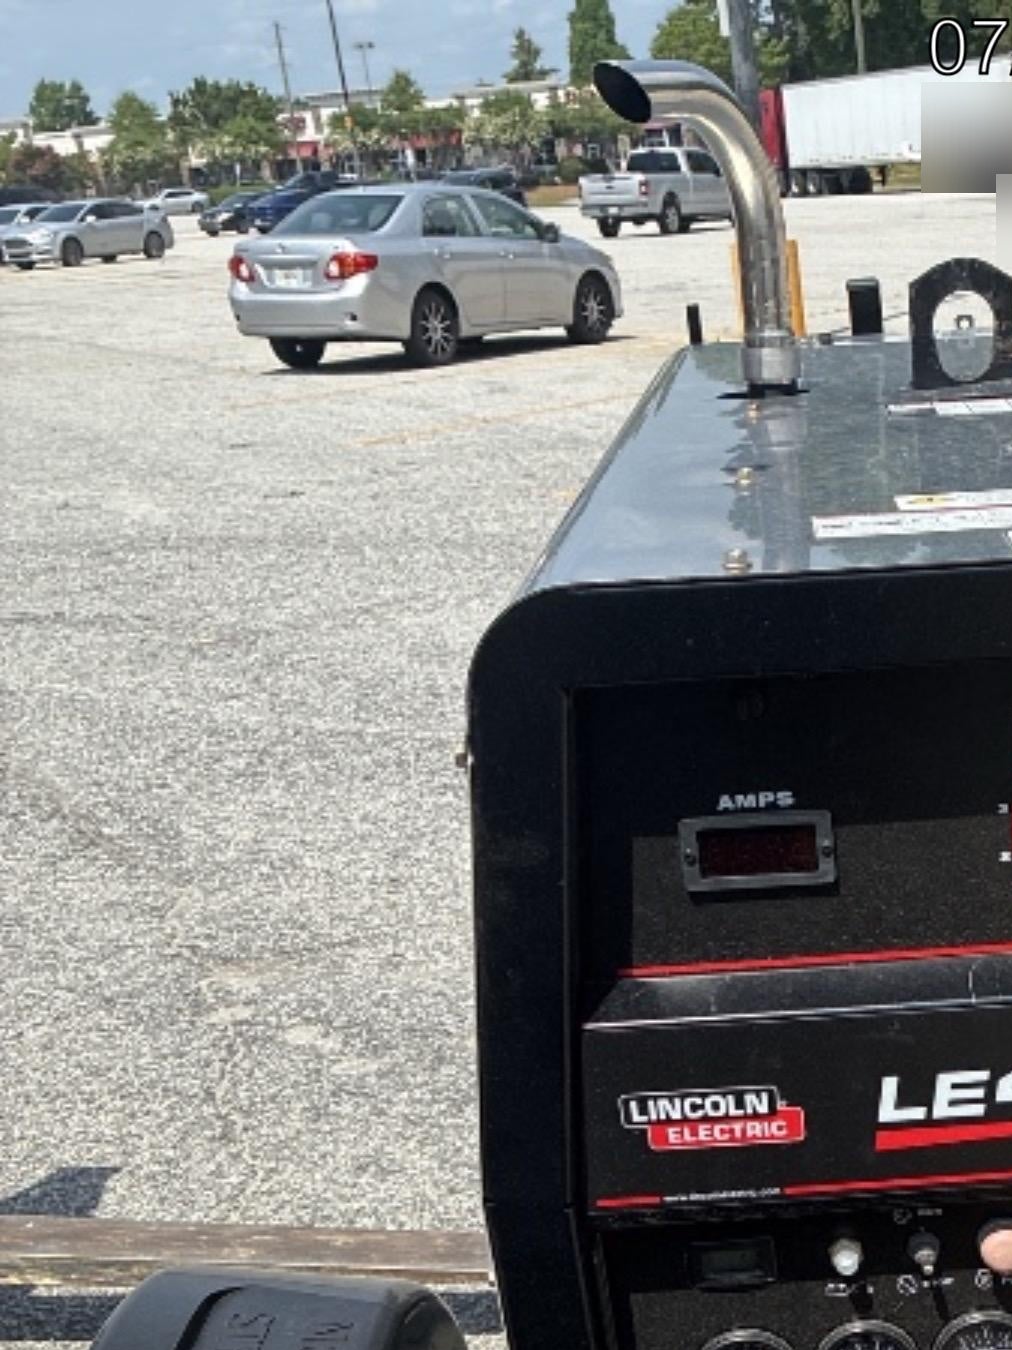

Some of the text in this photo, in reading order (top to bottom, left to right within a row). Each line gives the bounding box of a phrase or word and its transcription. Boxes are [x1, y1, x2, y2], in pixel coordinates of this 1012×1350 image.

[716, 791, 795, 811] AMPS
[629, 1092, 768, 1120] LINCOLN
[667, 1120, 787, 1143] ELECTRIC
